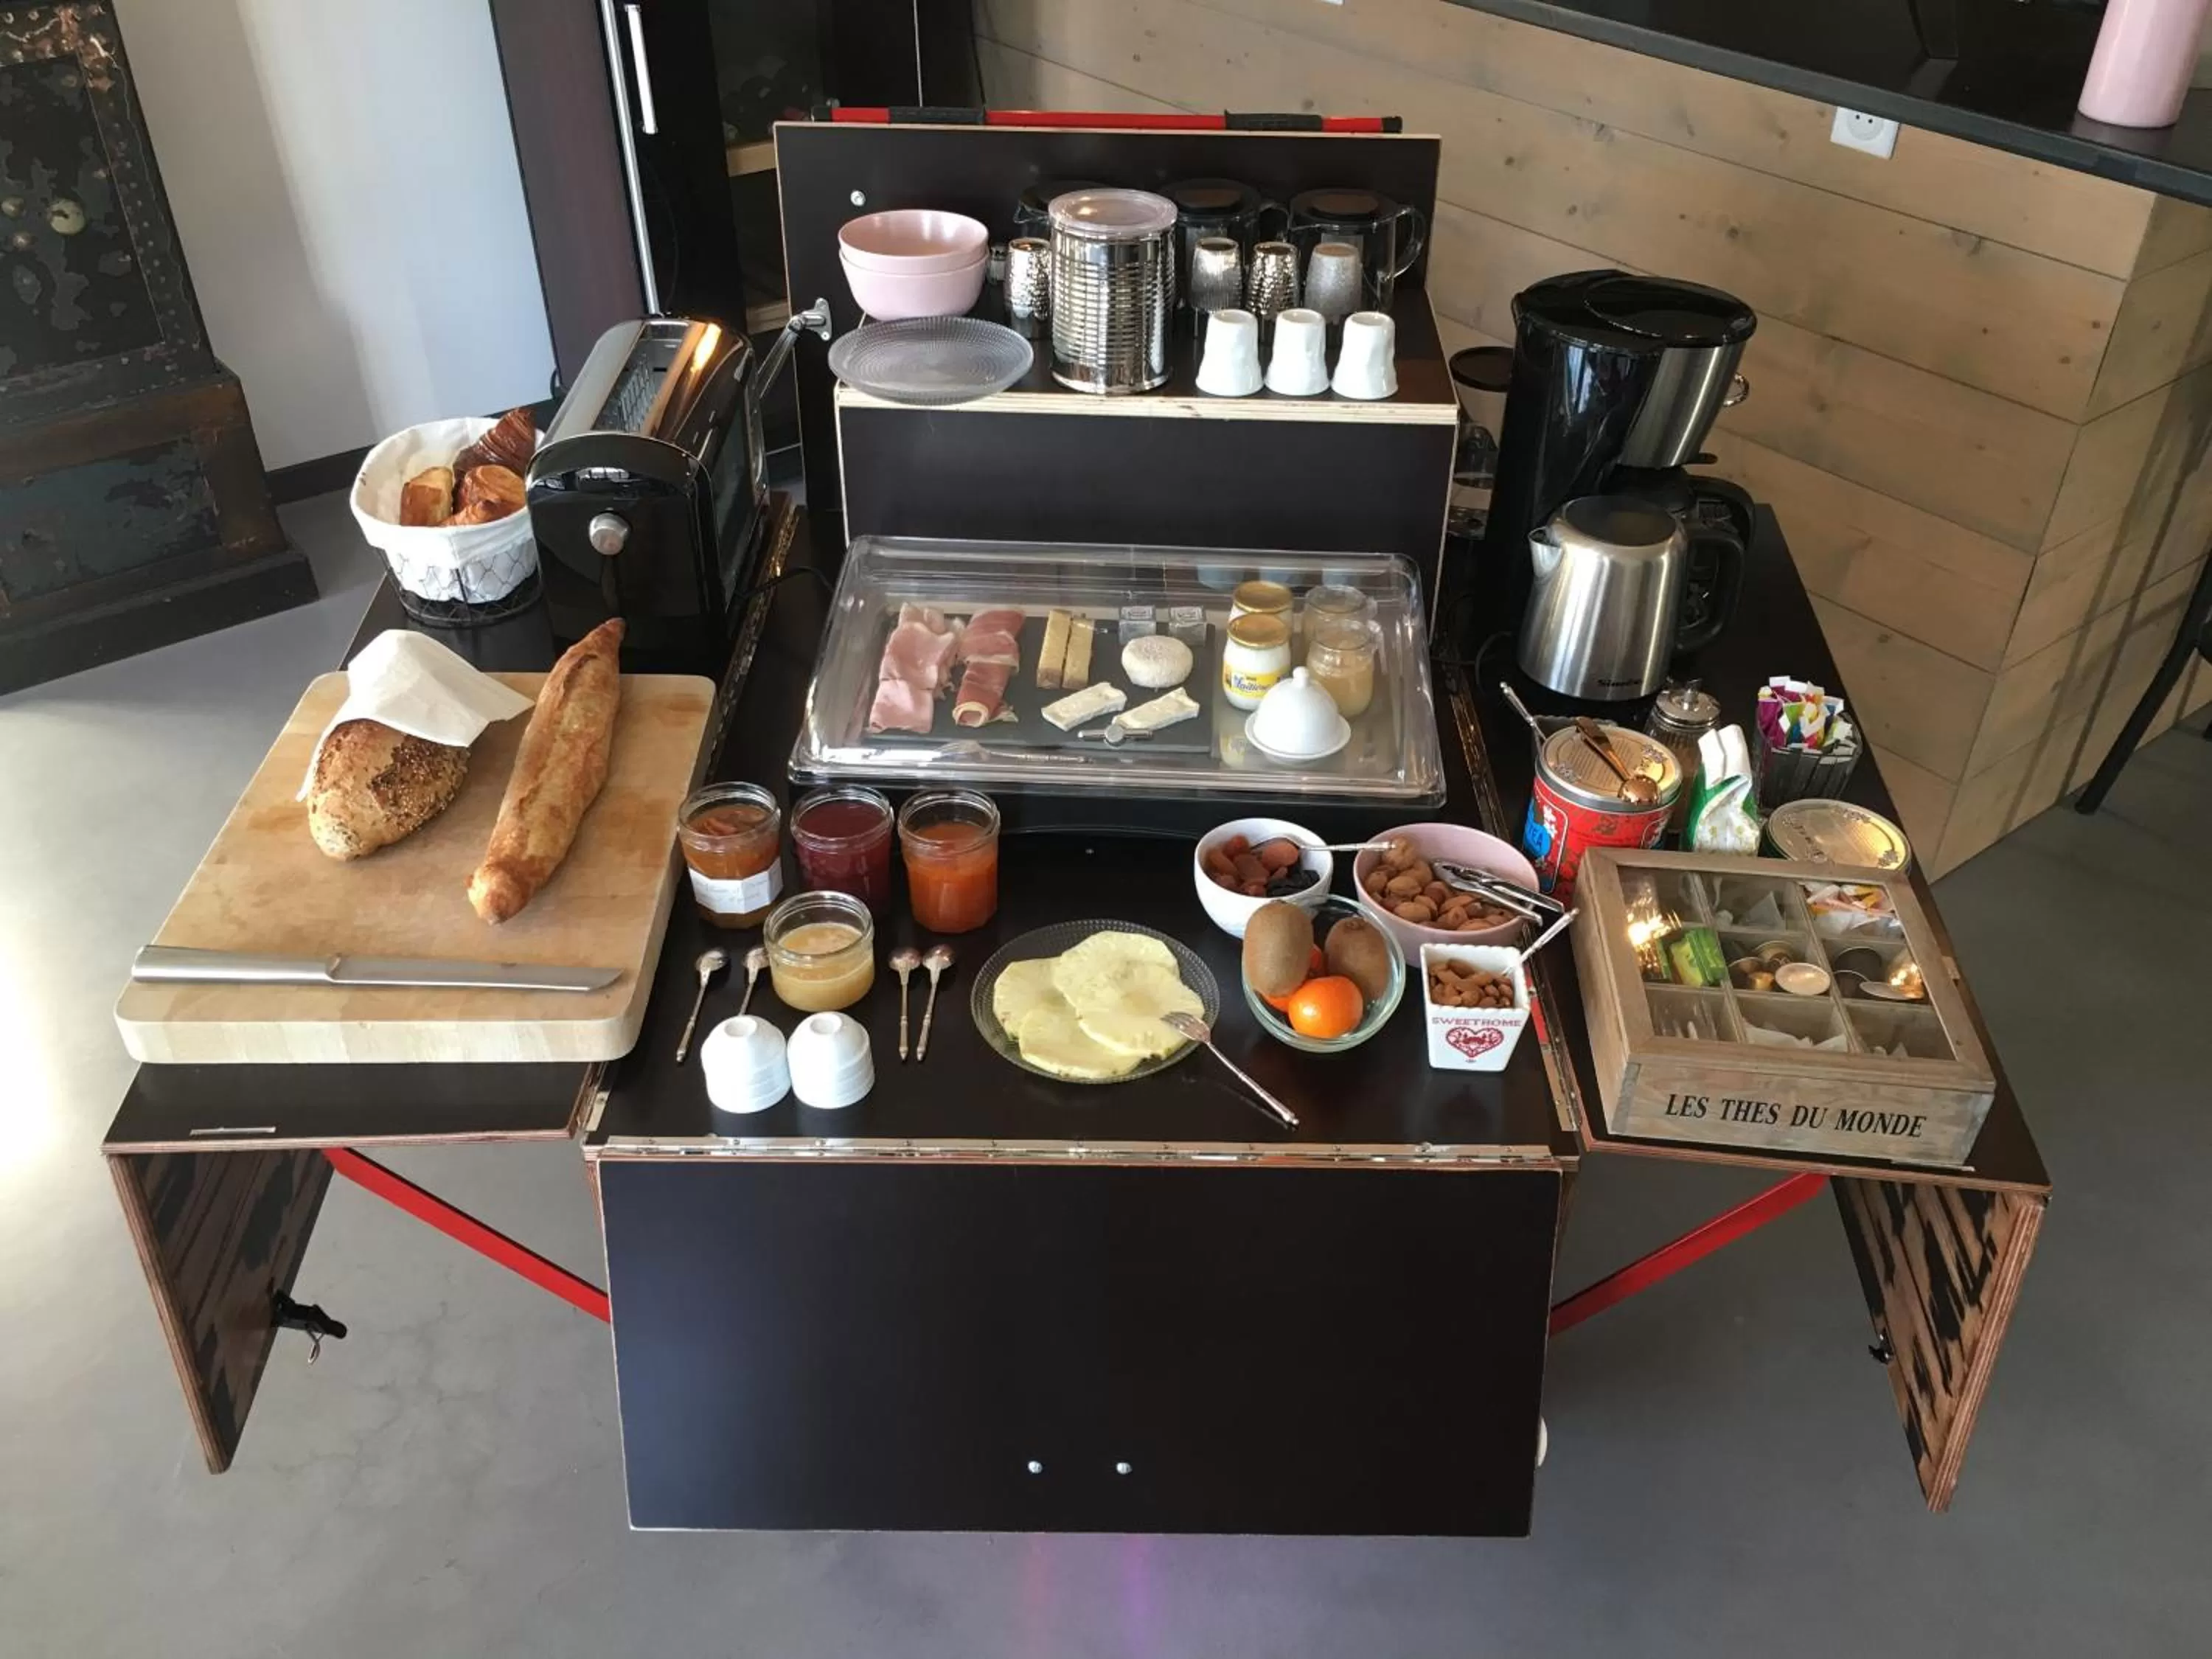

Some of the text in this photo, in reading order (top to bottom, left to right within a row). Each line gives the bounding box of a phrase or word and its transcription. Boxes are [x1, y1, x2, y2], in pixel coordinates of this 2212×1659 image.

[1665, 1093, 1927, 1138] LES THES DU MONDE
